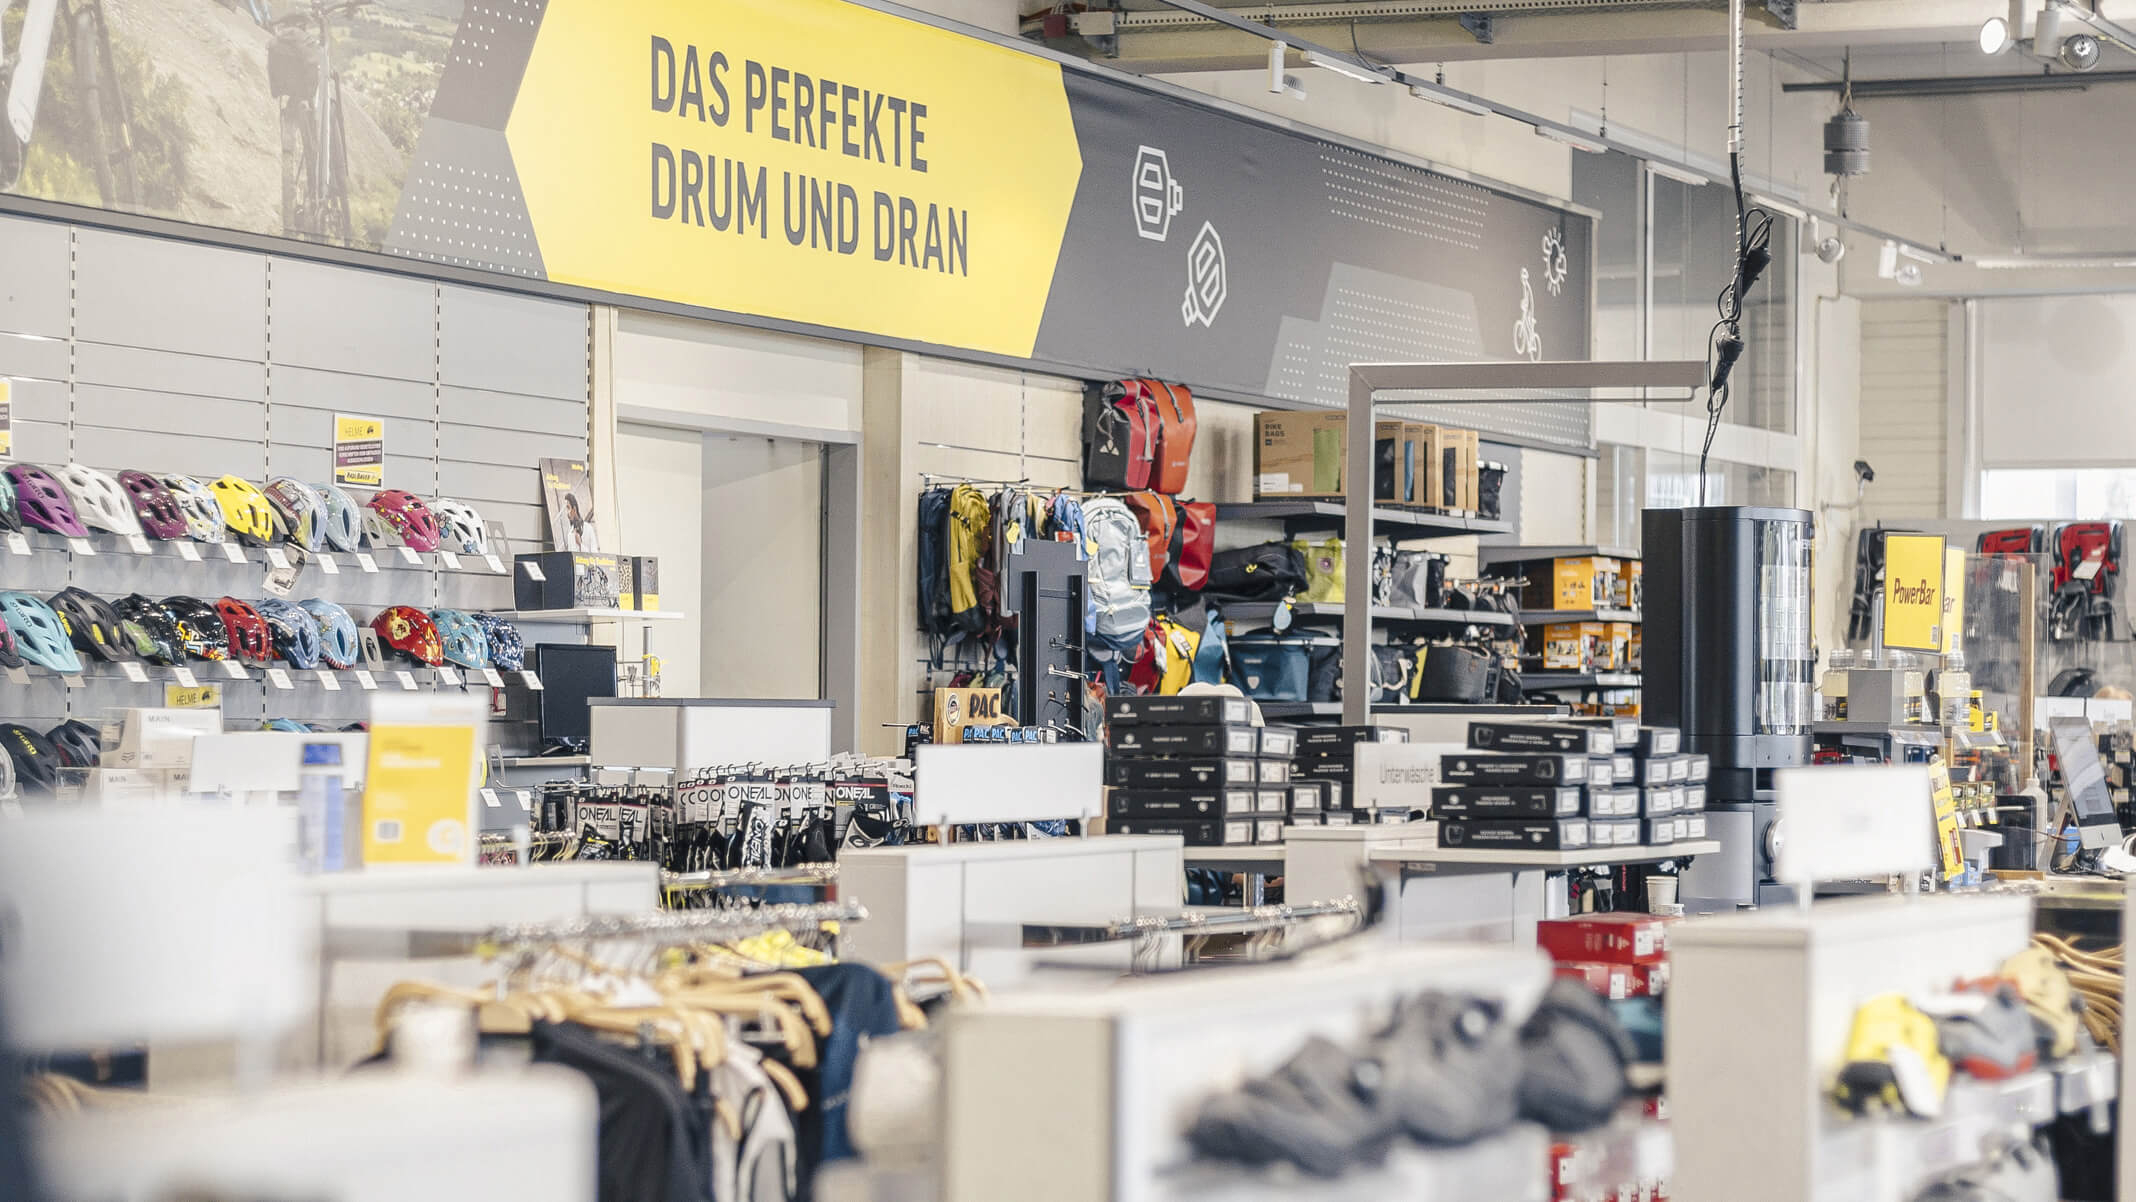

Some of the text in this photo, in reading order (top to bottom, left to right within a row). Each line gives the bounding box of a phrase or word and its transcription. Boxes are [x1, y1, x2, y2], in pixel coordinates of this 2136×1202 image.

[651, 34, 928, 174] DAS PERFEKTE
[651, 142, 968, 278] DRUM UND DRAN
[1893, 578, 1935, 605] PowerBar
[176, 692, 198, 705] HELME
[969, 694, 1000, 719] PAC
[973, 728, 991, 740] PAC
[991, 728, 1006, 739] PAC
[1011, 730, 1023, 742] PAC
[1024, 729, 1038, 742] PAC
[174, 773, 190, 781] MAI
